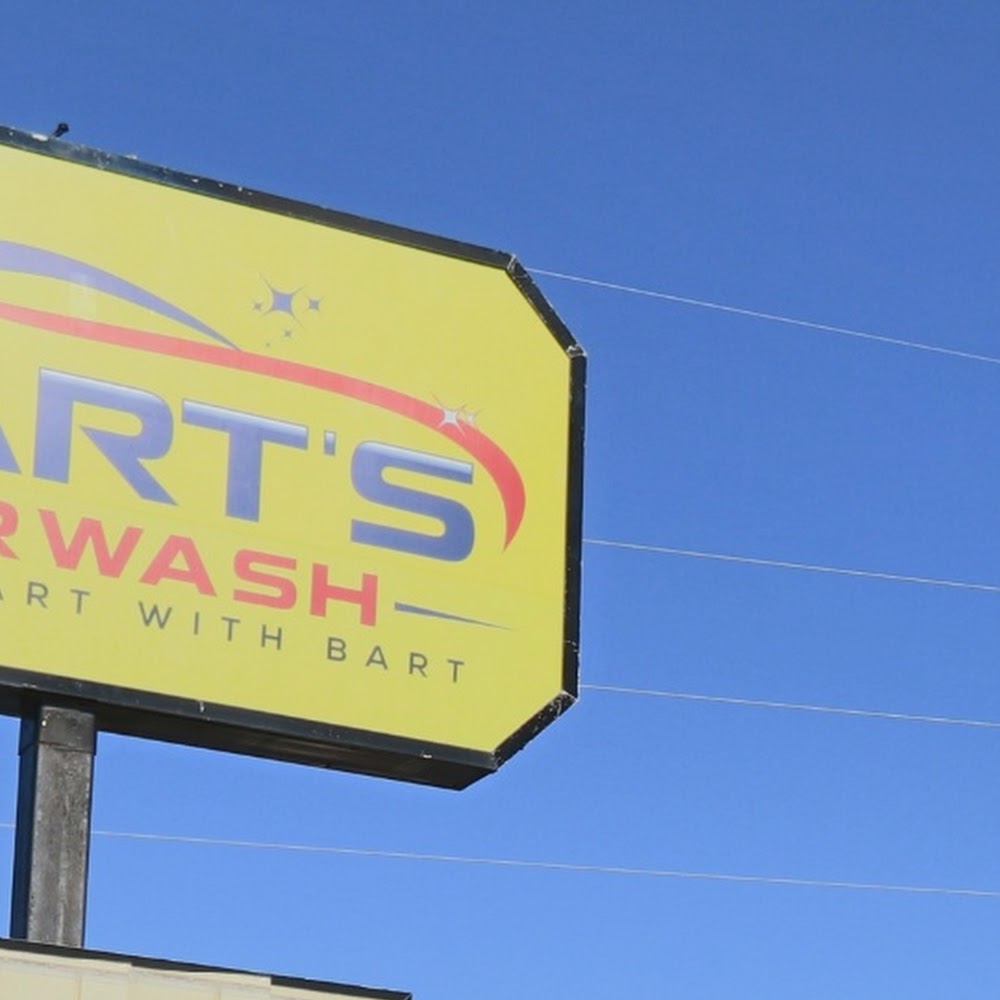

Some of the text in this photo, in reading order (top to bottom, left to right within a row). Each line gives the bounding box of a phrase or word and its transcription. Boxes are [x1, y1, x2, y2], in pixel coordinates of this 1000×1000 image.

[0, 366, 475, 563] RT'S
[0, 500, 378, 627] WASH
[0, 580, 465, 684] RT WITH BART
